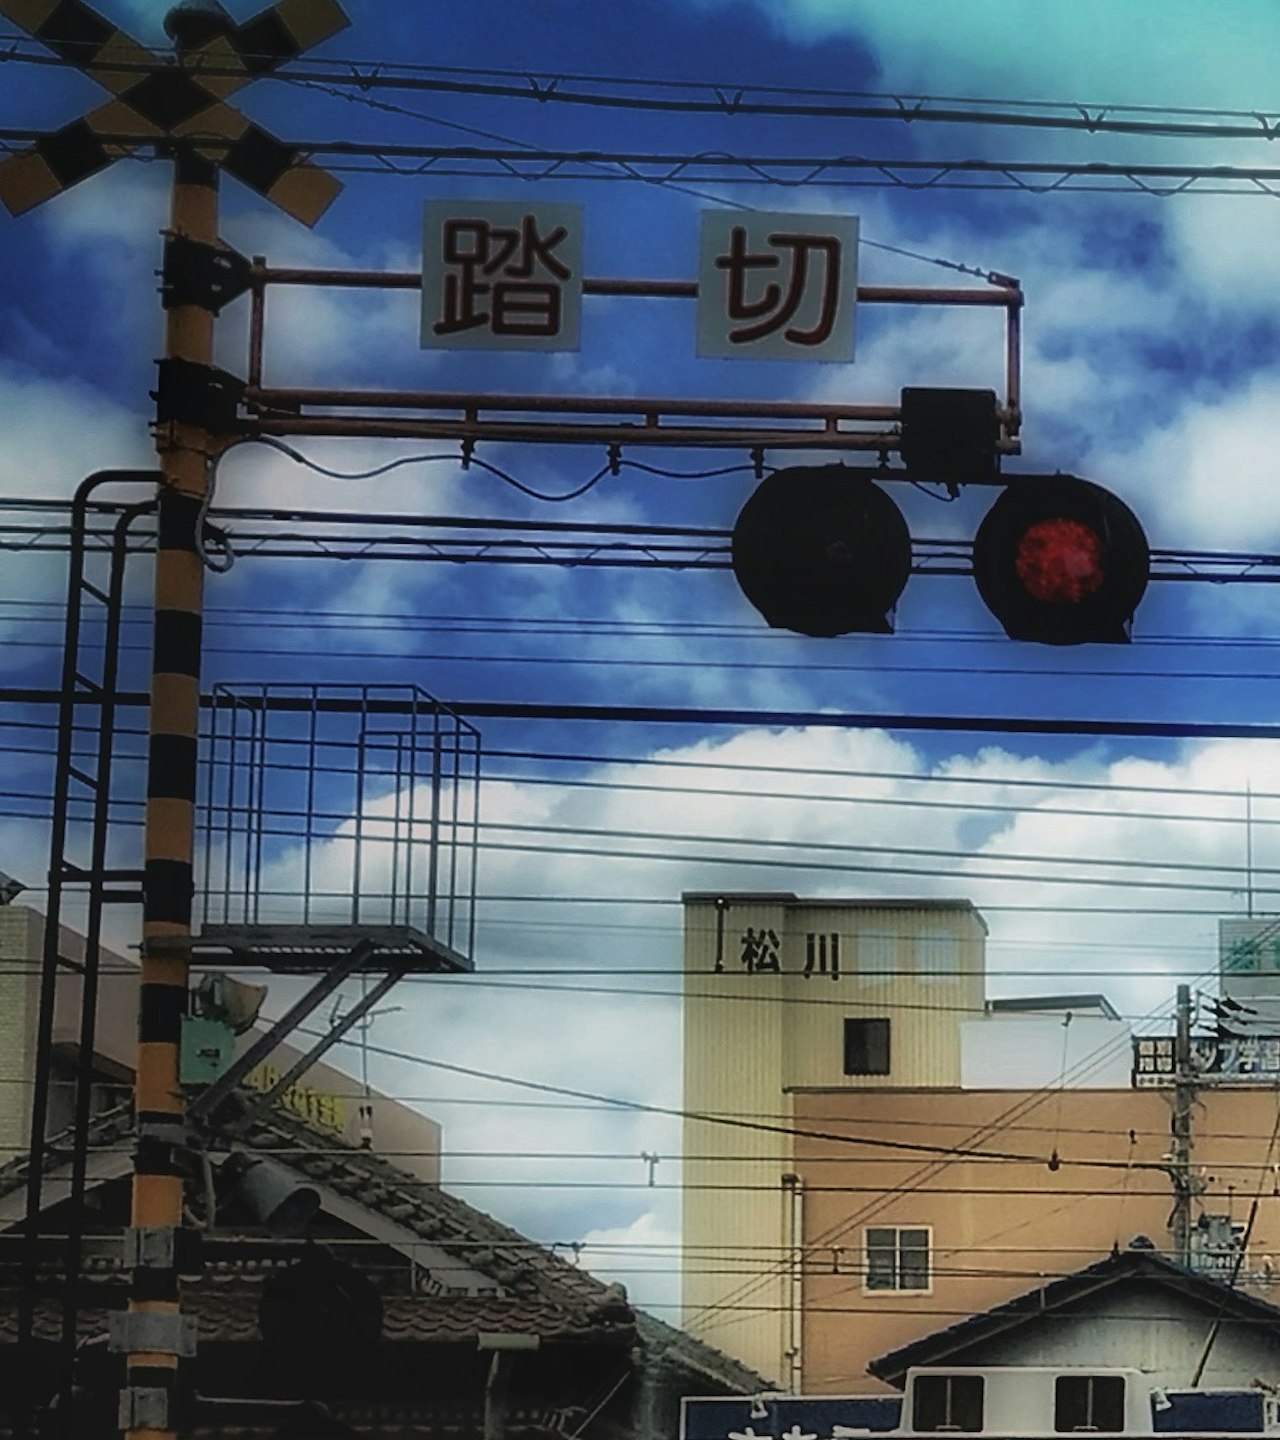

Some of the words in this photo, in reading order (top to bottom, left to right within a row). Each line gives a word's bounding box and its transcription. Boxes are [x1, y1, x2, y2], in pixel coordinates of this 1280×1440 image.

[433, 215, 571, 336] 踏
[714, 226, 843, 346] 切
[741, 927, 839, 981] 松川
